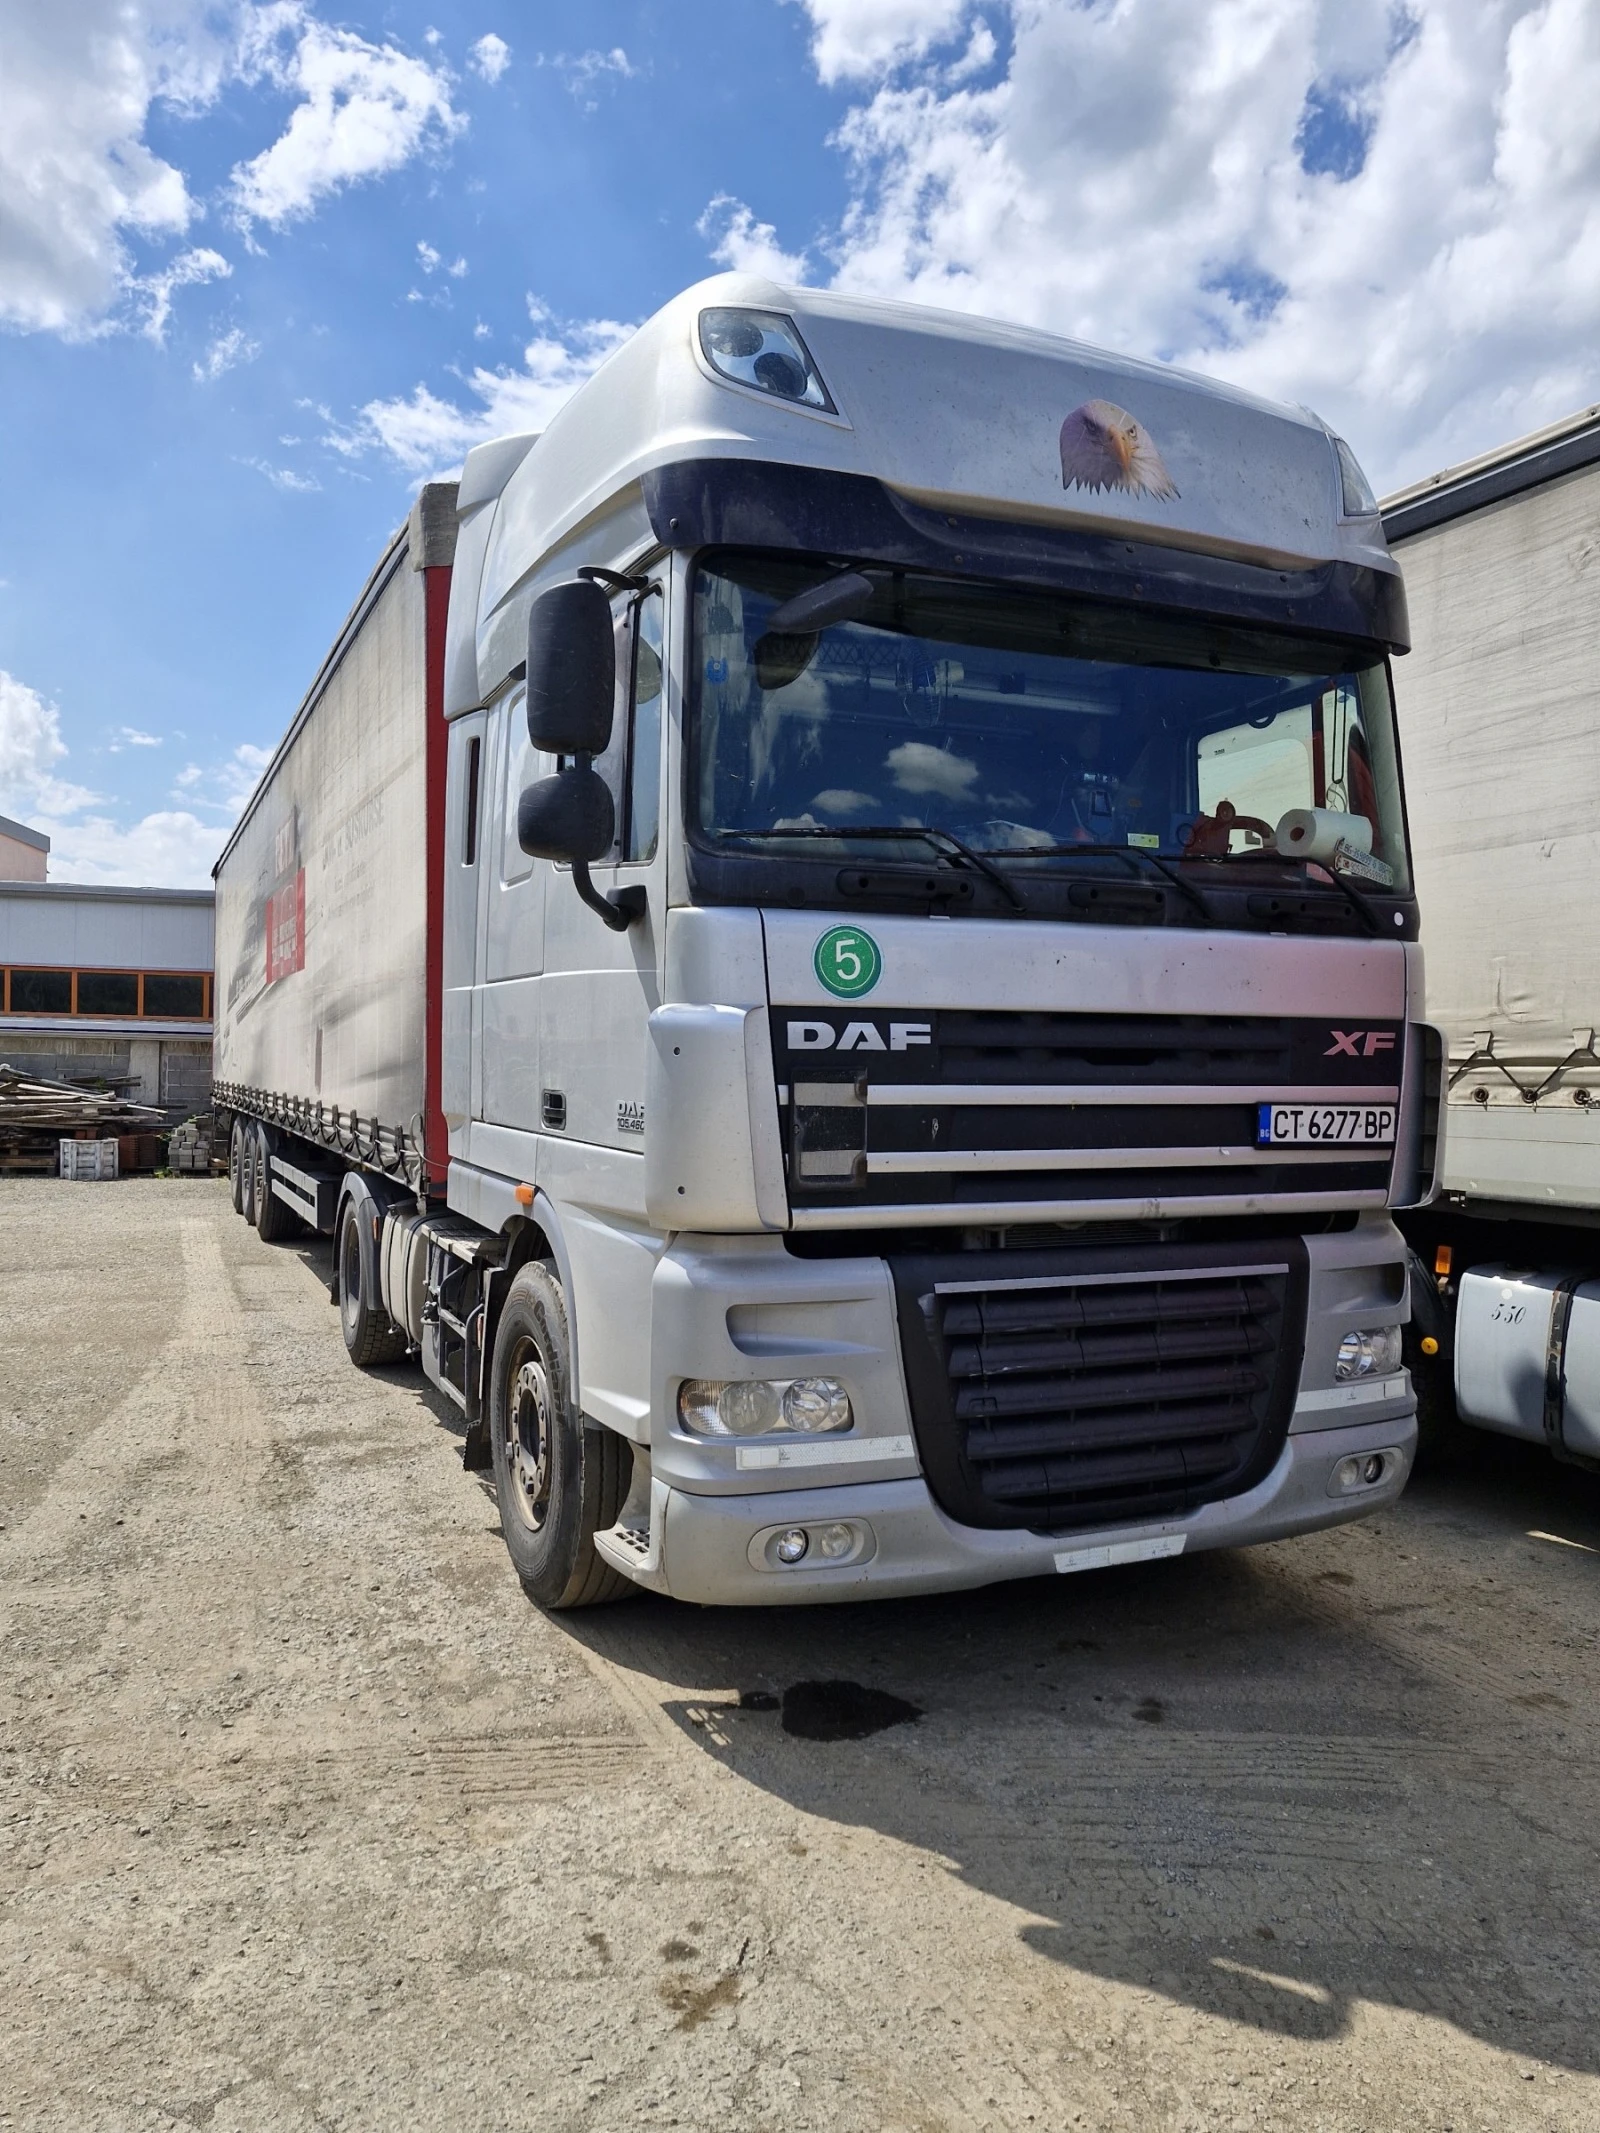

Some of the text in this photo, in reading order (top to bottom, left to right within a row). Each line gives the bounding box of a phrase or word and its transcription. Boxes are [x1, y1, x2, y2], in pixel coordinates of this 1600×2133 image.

[835, 938, 861, 981] 5
[787, 1021, 932, 1051] DAF
[1322, 1031, 1396, 1056] XF
[1260, 1128, 1270, 1138] BG
[1274, 1110, 1392, 1139] CT 6277 BP
[1491, 1303, 1527, 1325] 550
